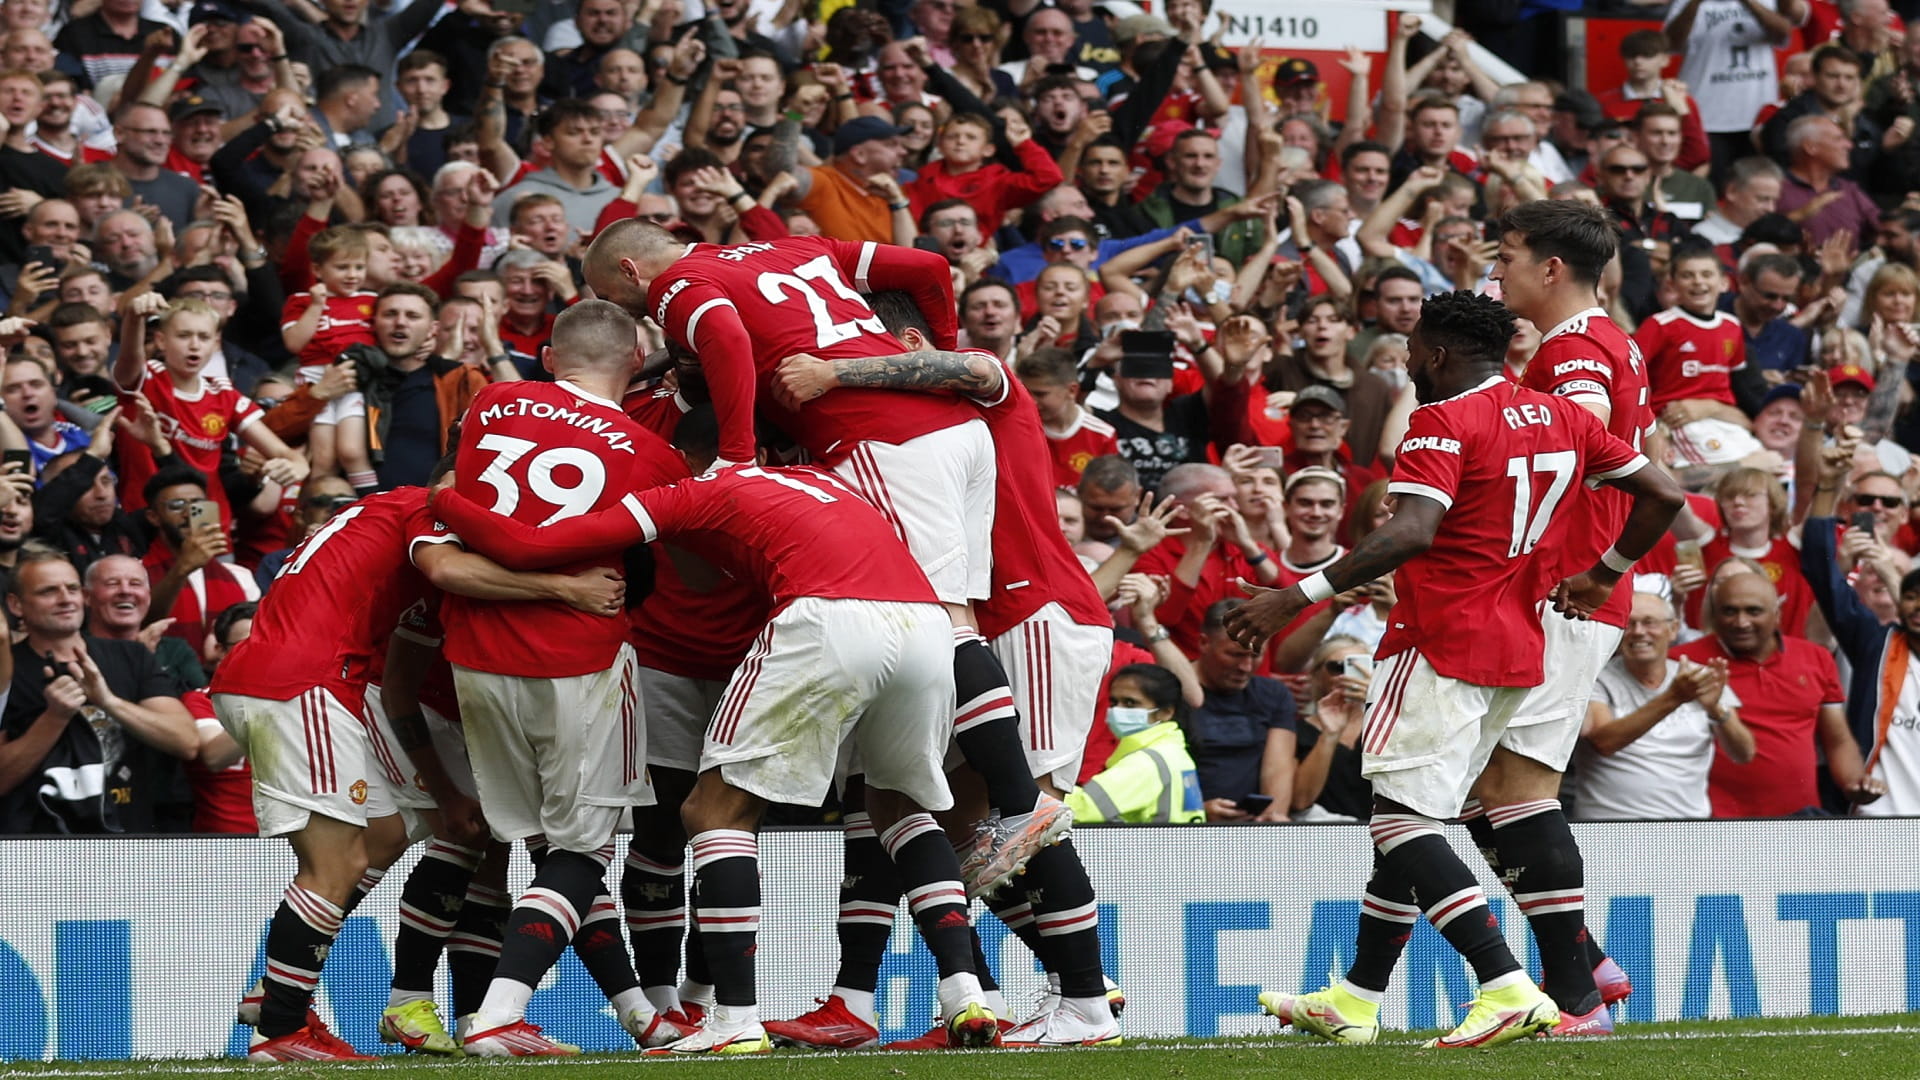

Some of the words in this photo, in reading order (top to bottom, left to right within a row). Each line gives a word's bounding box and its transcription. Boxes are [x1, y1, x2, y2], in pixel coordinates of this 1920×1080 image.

[757, 255, 888, 349] 23
[1553, 359, 1612, 380] KOHLER
[479, 398, 636, 455] McTOMINAY
[1401, 437, 1462, 455] KOHLER
[1503, 403, 1552, 431] FRED
[476, 433, 607, 529] 39
[1506, 450, 1577, 559] 17
[274, 506, 366, 581] 1
